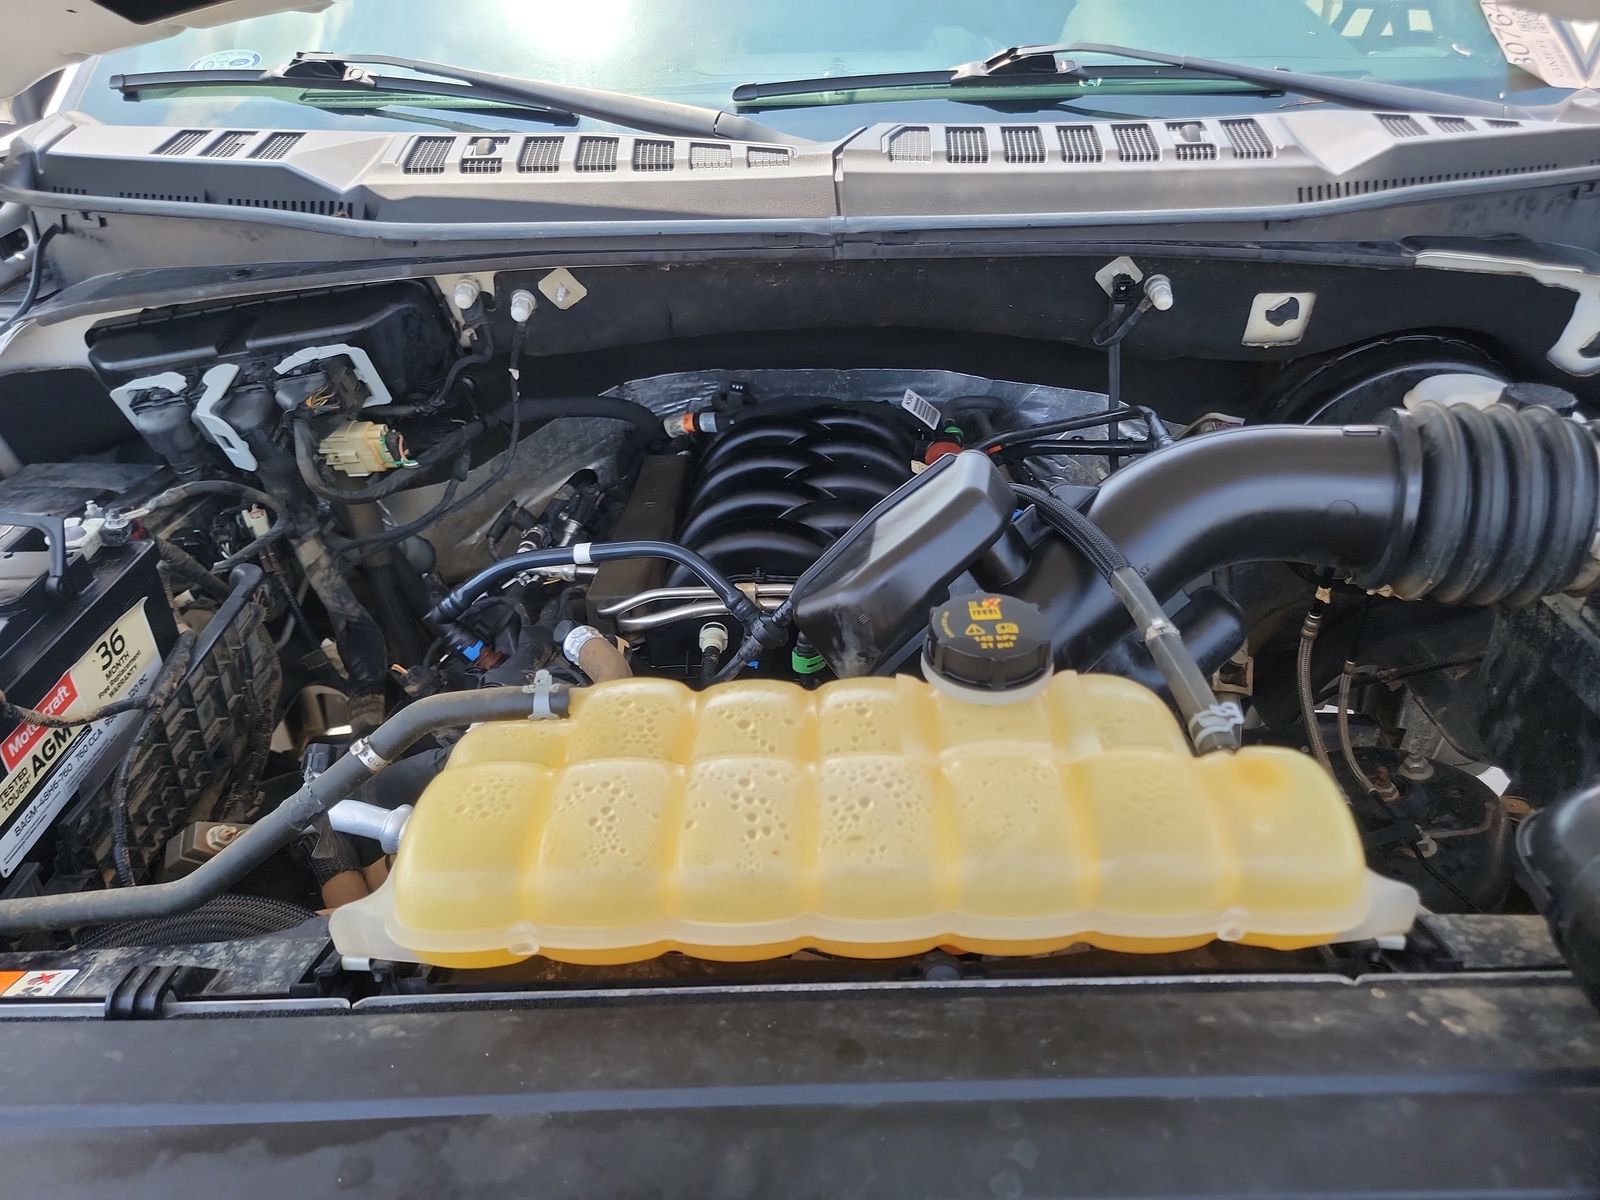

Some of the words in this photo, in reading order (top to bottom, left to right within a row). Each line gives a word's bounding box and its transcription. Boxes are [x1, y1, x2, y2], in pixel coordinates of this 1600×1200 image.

[96, 627, 125, 671] 36
[105, 651, 130, 680] MONTH
[109, 664, 137, 698] WARRANTY
[31, 727, 72, 778] AGM
[74, 744, 89, 762] 760
[88, 728, 103, 746] CCA
[0, 767, 28, 803] TESTED
